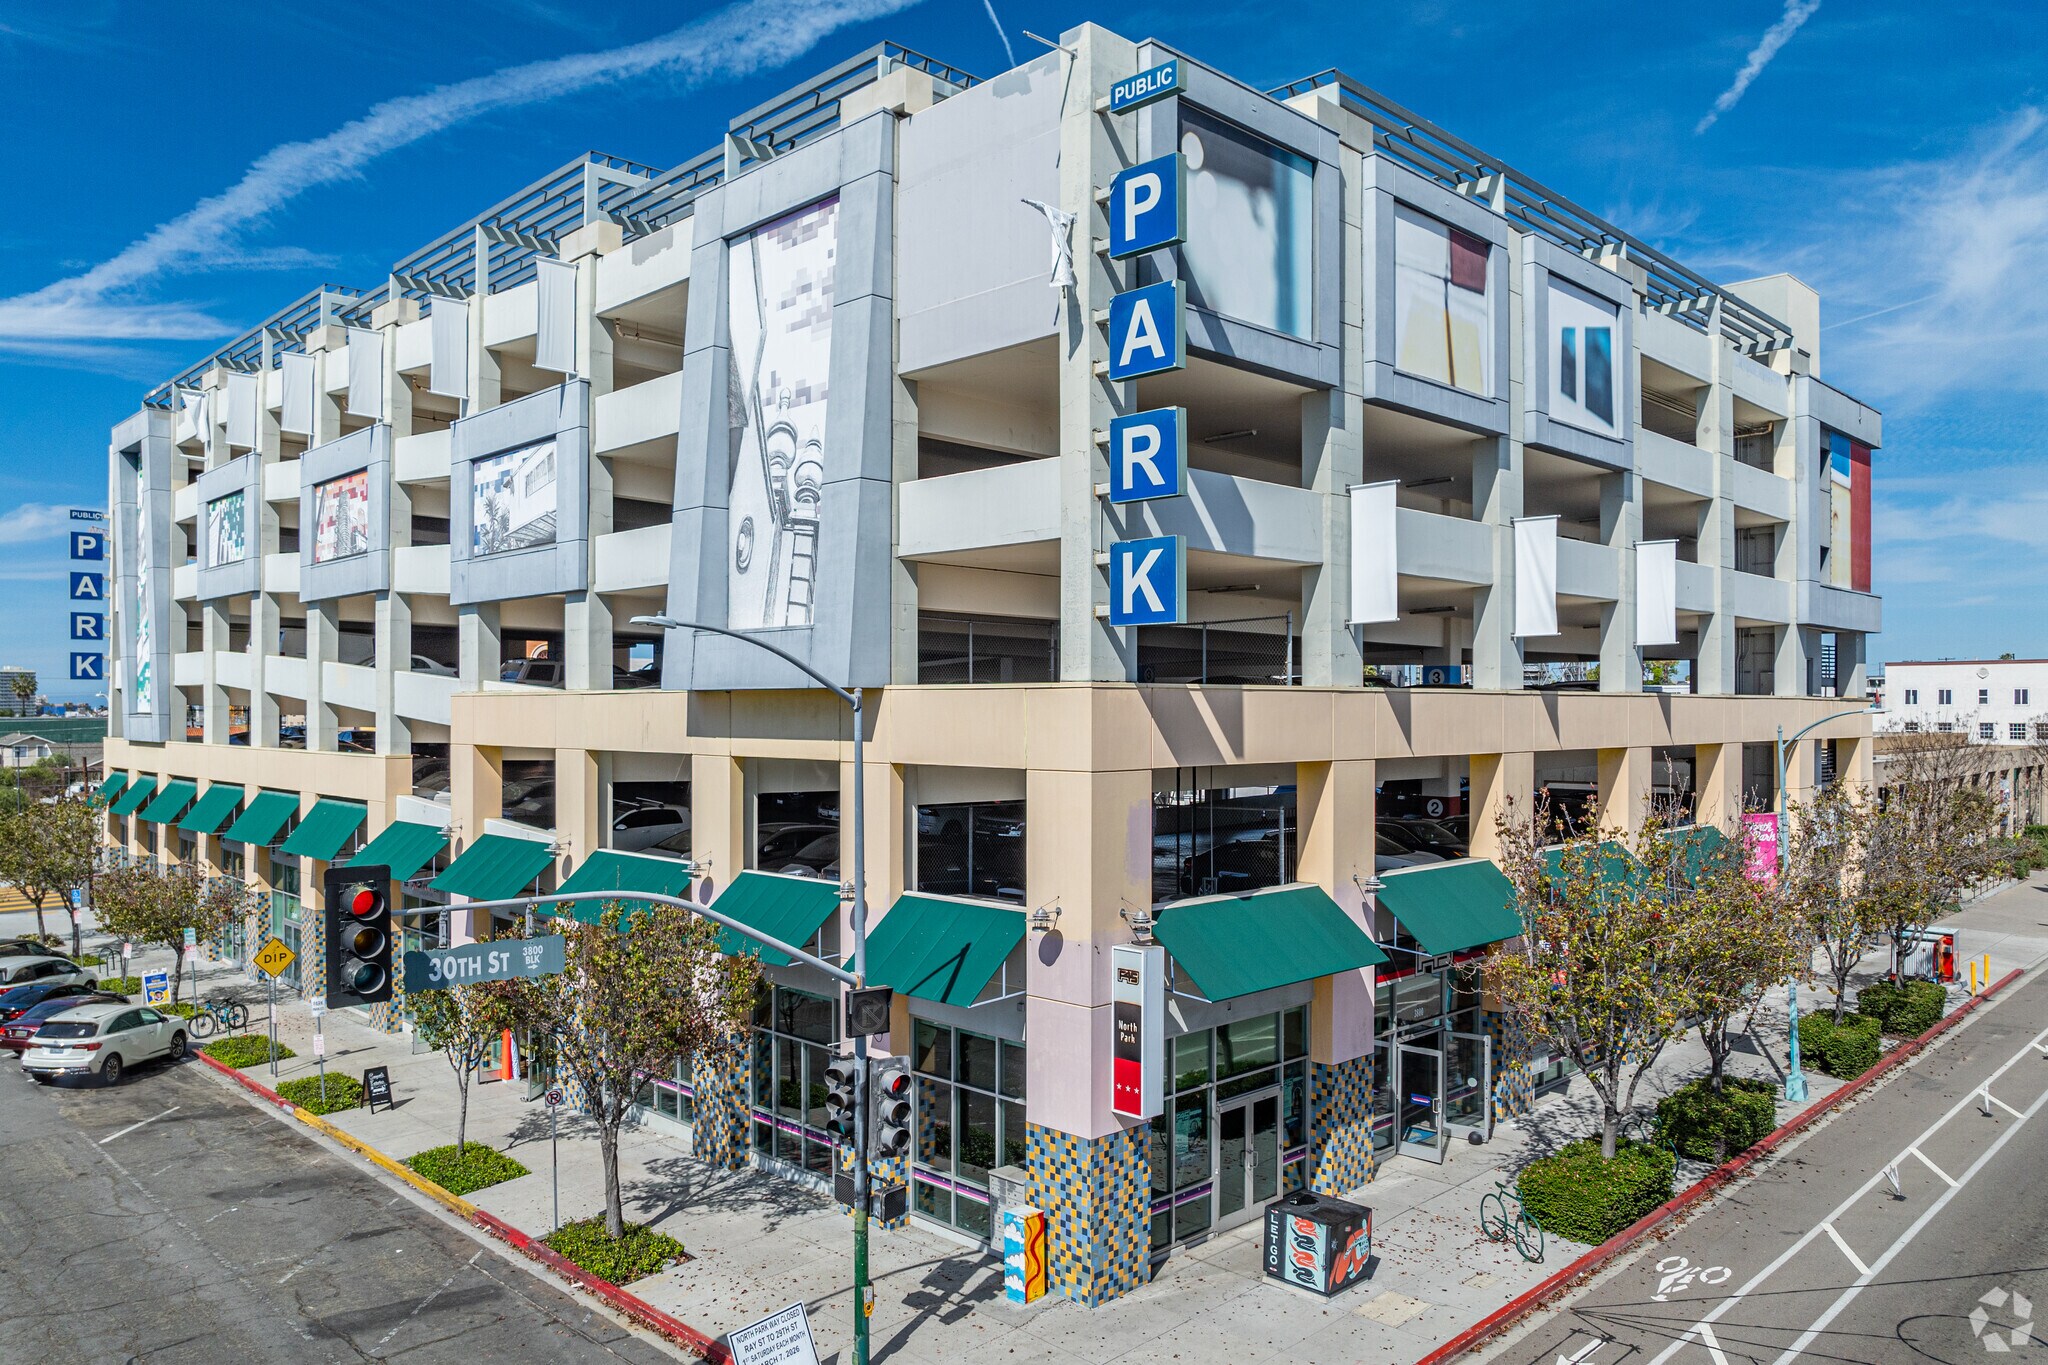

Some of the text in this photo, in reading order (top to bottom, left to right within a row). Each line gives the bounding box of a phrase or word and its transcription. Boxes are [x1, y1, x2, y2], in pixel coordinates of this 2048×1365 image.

[1114, 67, 1173, 104] PUBLIC
[1119, 172, 1166, 615] PARK
[72, 511, 101, 519] PUBLIC
[75, 535, 98, 677] PARK
[1432, 671, 1441, 684] 3
[1430, 801, 1440, 815] 2
[522, 945, 544, 957] 3800
[264, 952, 287, 964] DIP
[525, 954, 541, 965] BLK
[428, 951, 510, 982] 30TH ST
[1118, 1019, 1138, 1032] North
[1120, 1031, 1136, 1044] Park
[736, 1309, 801, 1344] NORTH PARK WAY CLOSED
[744, 1322, 798, 1353] RAY ST TO 29TH ST
[750, 1344, 776, 1363] SATURDAY
[776, 1338, 789, 1350] EACH
[789, 1330, 806, 1344] MONTH
[786, 1346, 800, 1358] 2026
